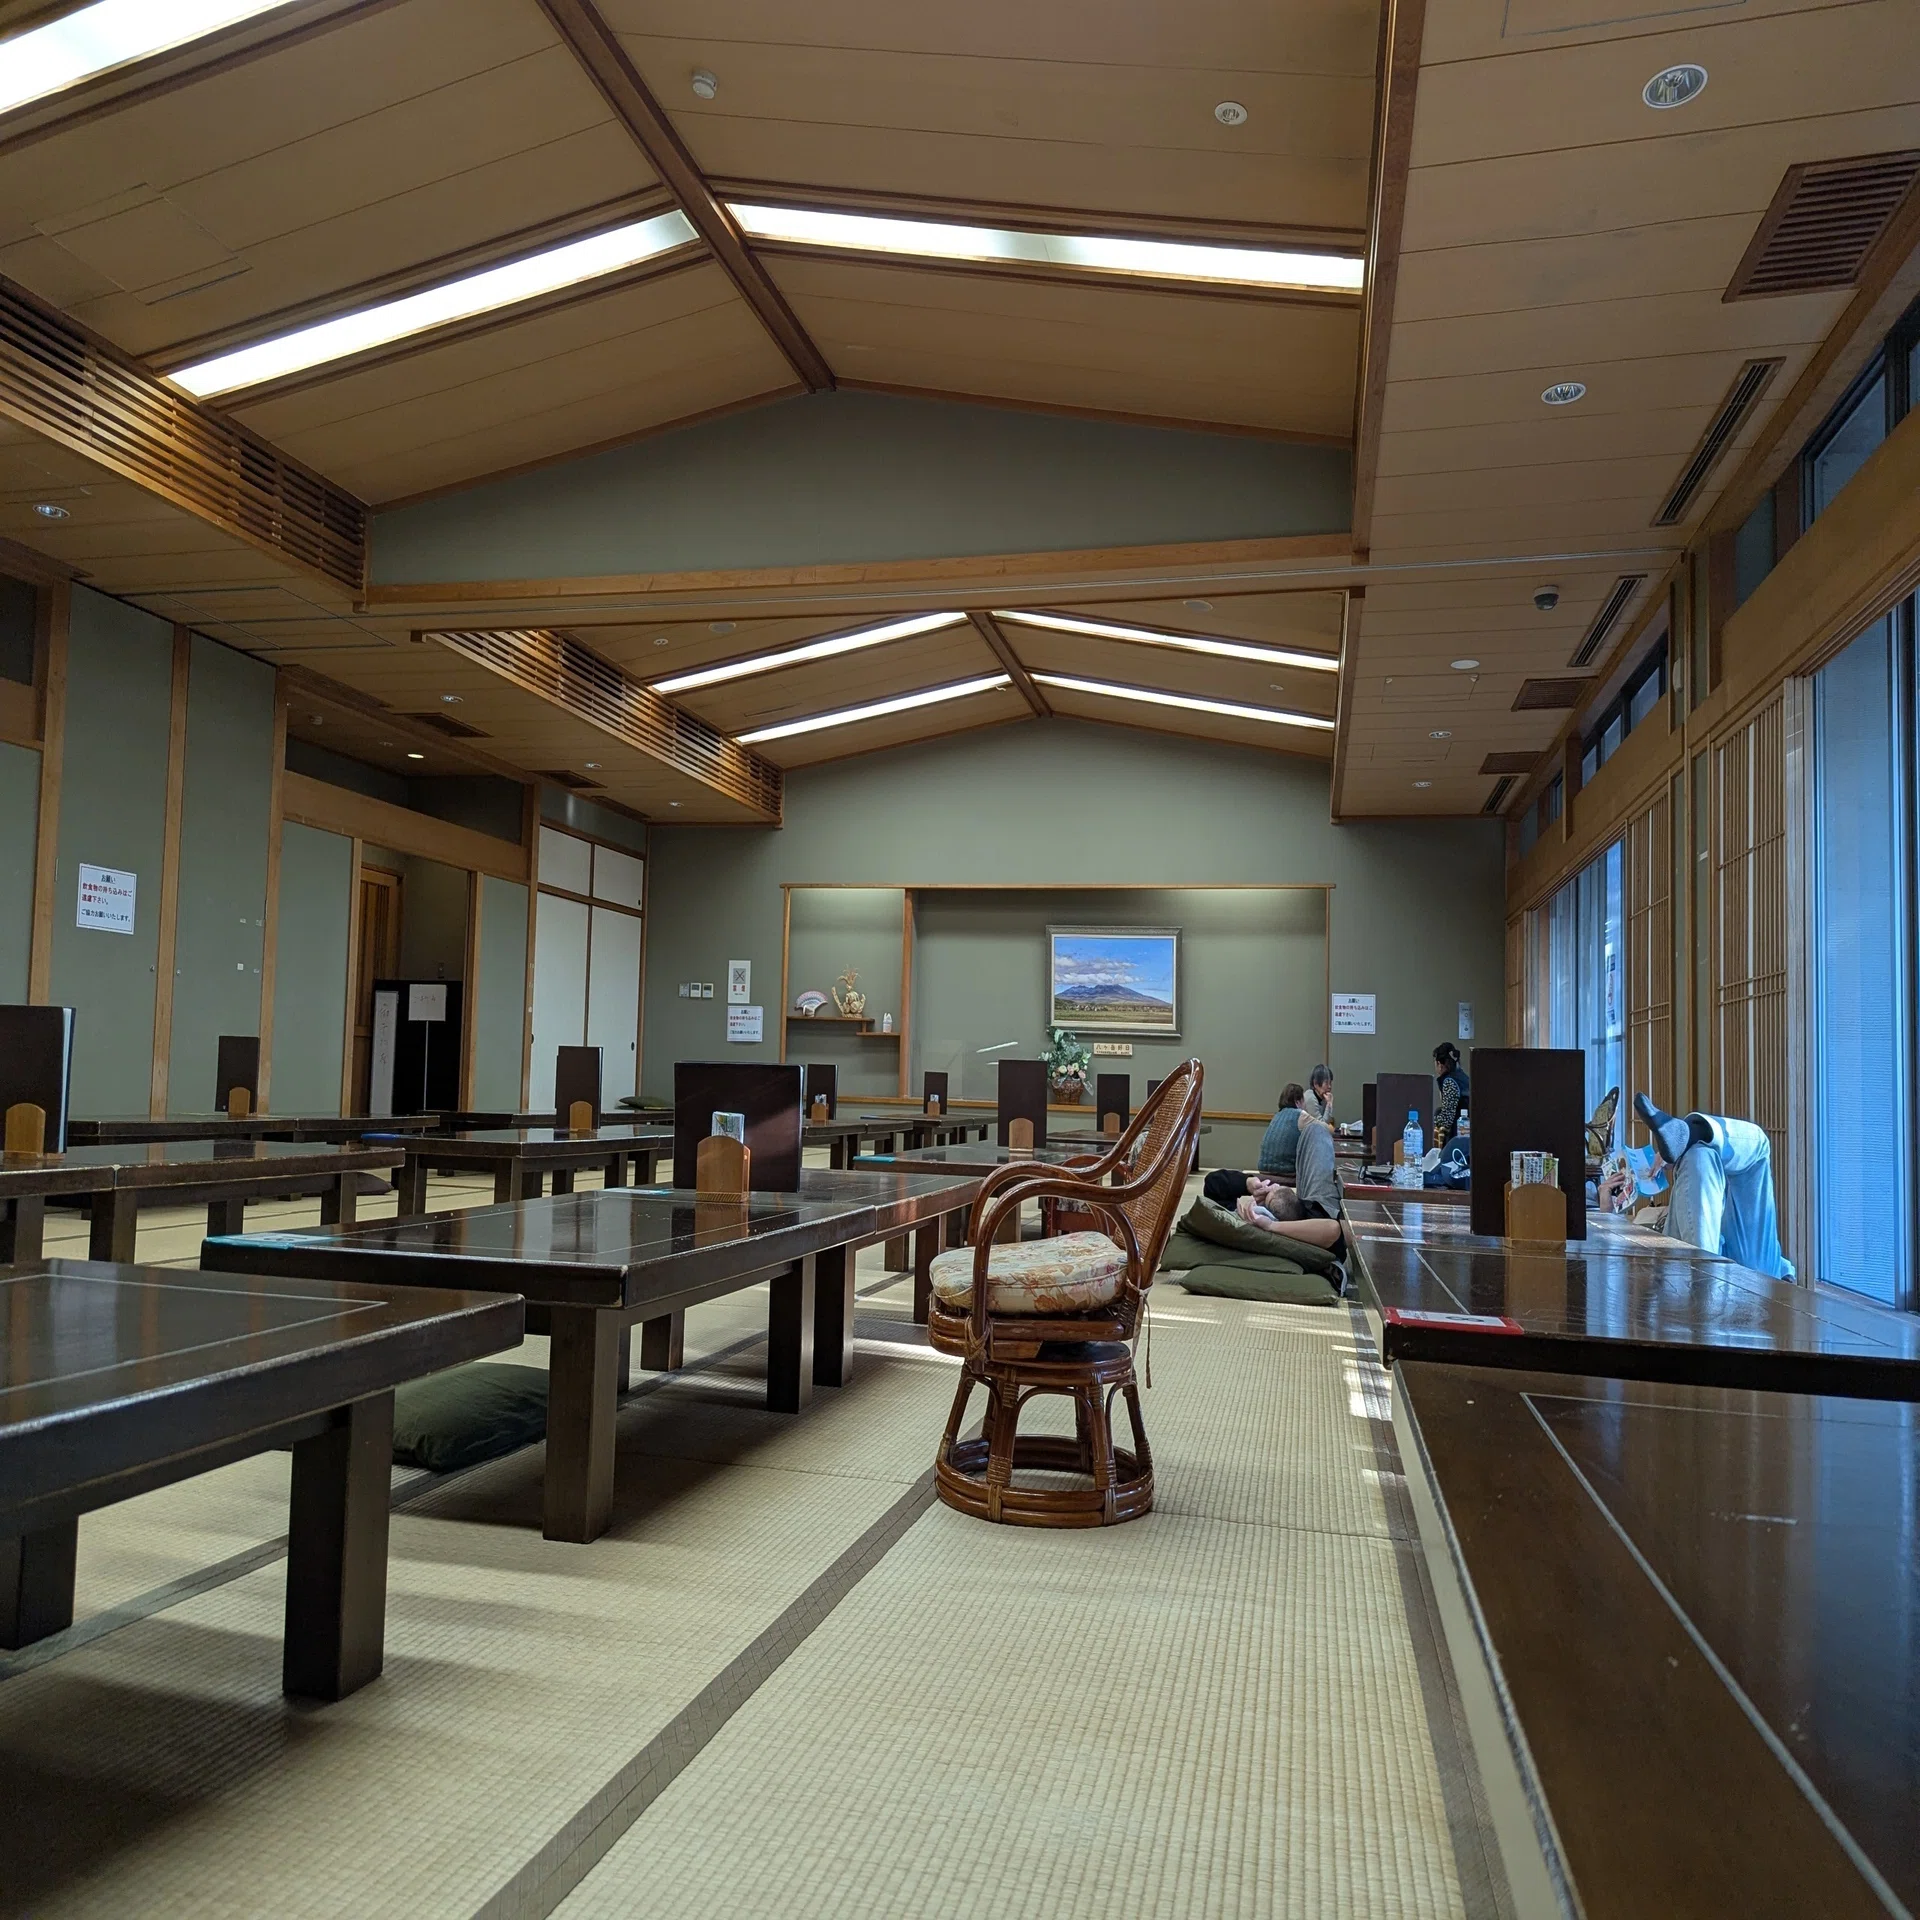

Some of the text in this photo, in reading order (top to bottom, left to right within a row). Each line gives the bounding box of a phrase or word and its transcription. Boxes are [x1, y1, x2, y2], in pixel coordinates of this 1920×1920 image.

[101, 874, 116, 883] お願い
[82, 882, 132, 897] 飲食物の持ち込みはご
[82, 894, 108, 905] 遠慮下さい。
